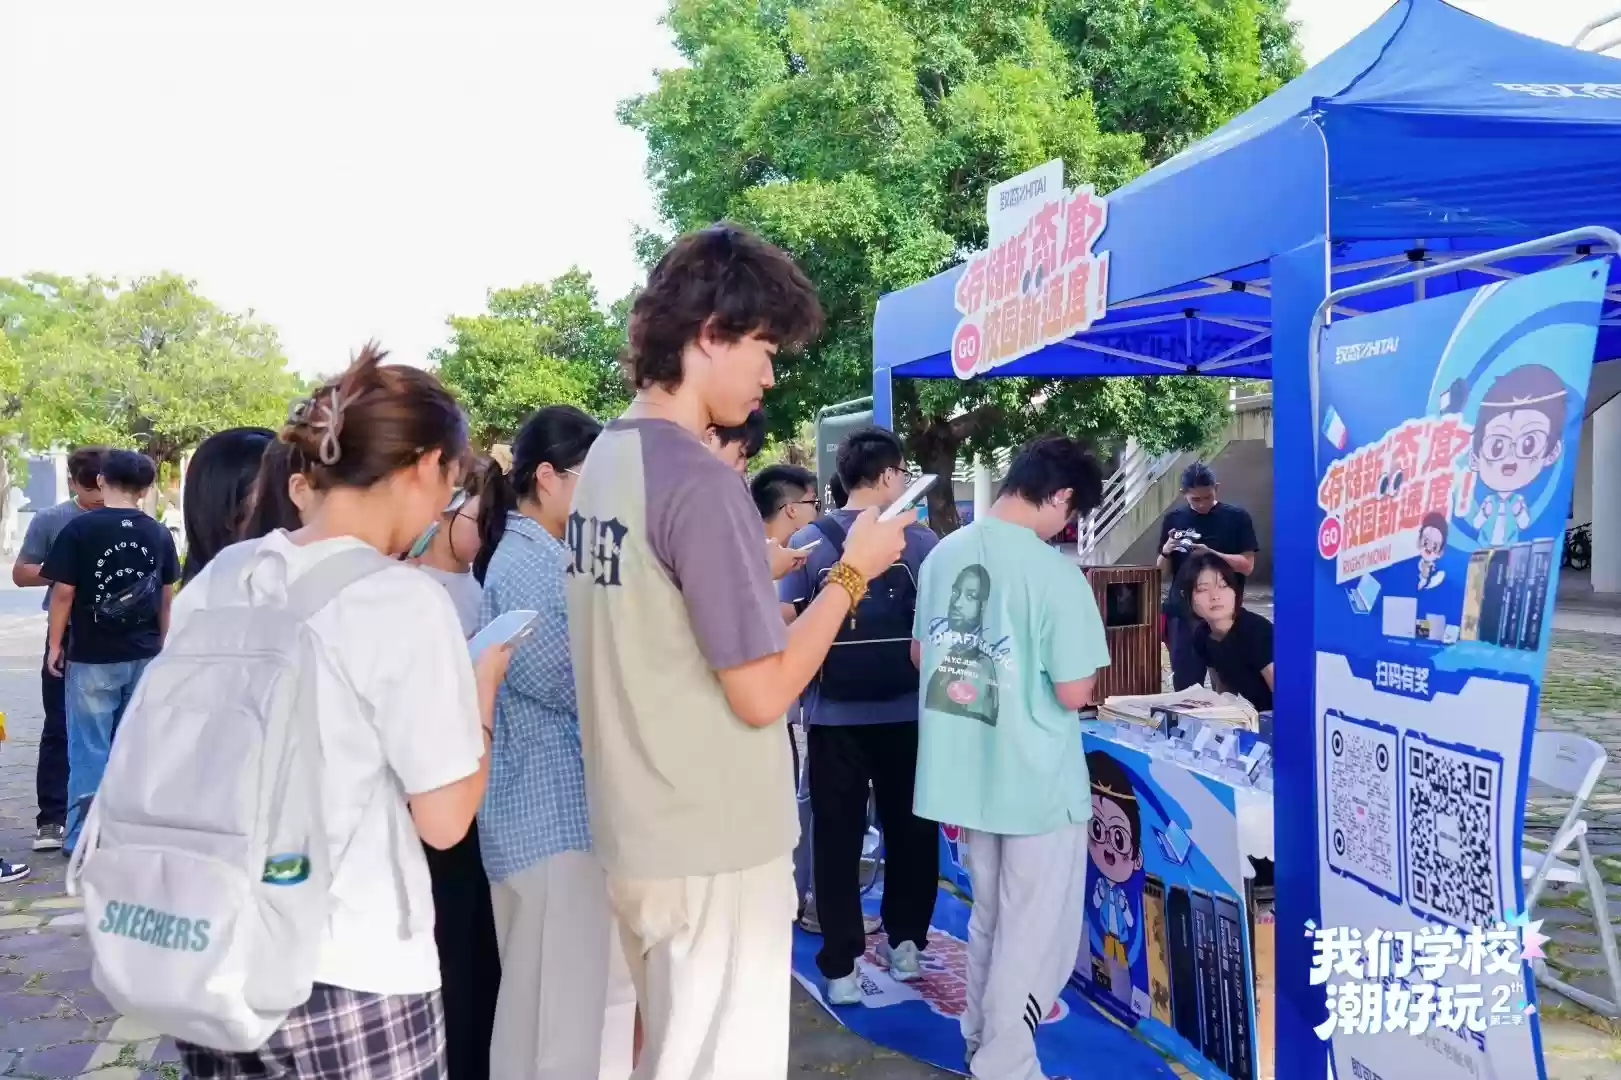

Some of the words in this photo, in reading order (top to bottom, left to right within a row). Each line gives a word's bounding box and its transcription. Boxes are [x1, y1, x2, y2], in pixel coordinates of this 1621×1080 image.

[958, 336, 976, 358] GO
[1322, 527, 1338, 546] GO
[1342, 554, 1367, 574] RIGHT
[1367, 544, 1392, 563] NOW!
[1376, 661, 1429, 696] 扫码有奖
[98, 899, 211, 952] SKECHERS
